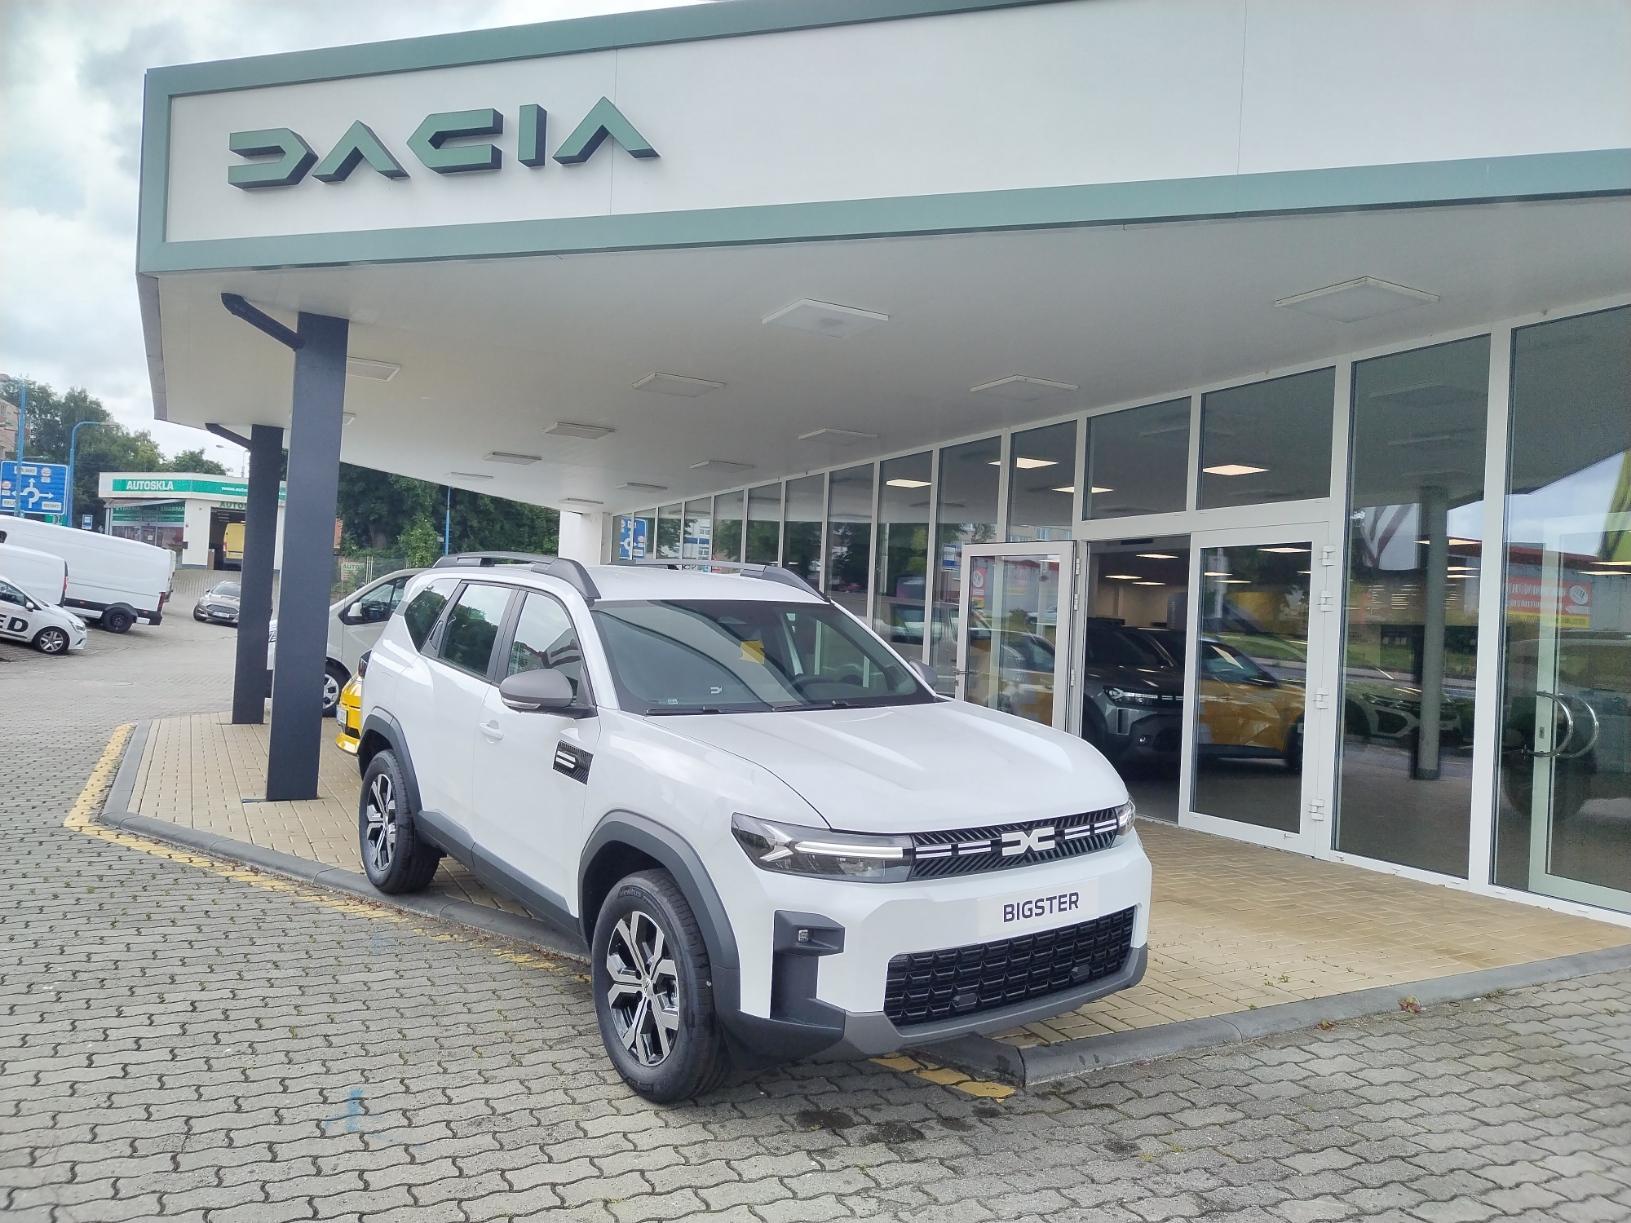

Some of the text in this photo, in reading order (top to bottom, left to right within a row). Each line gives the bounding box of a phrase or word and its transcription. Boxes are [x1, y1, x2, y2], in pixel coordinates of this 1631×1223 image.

[228, 96, 660, 191] DACIA
[126, 480, 174, 490] AUTOSKLA
[1003, 891, 1080, 922] BIGSTER
